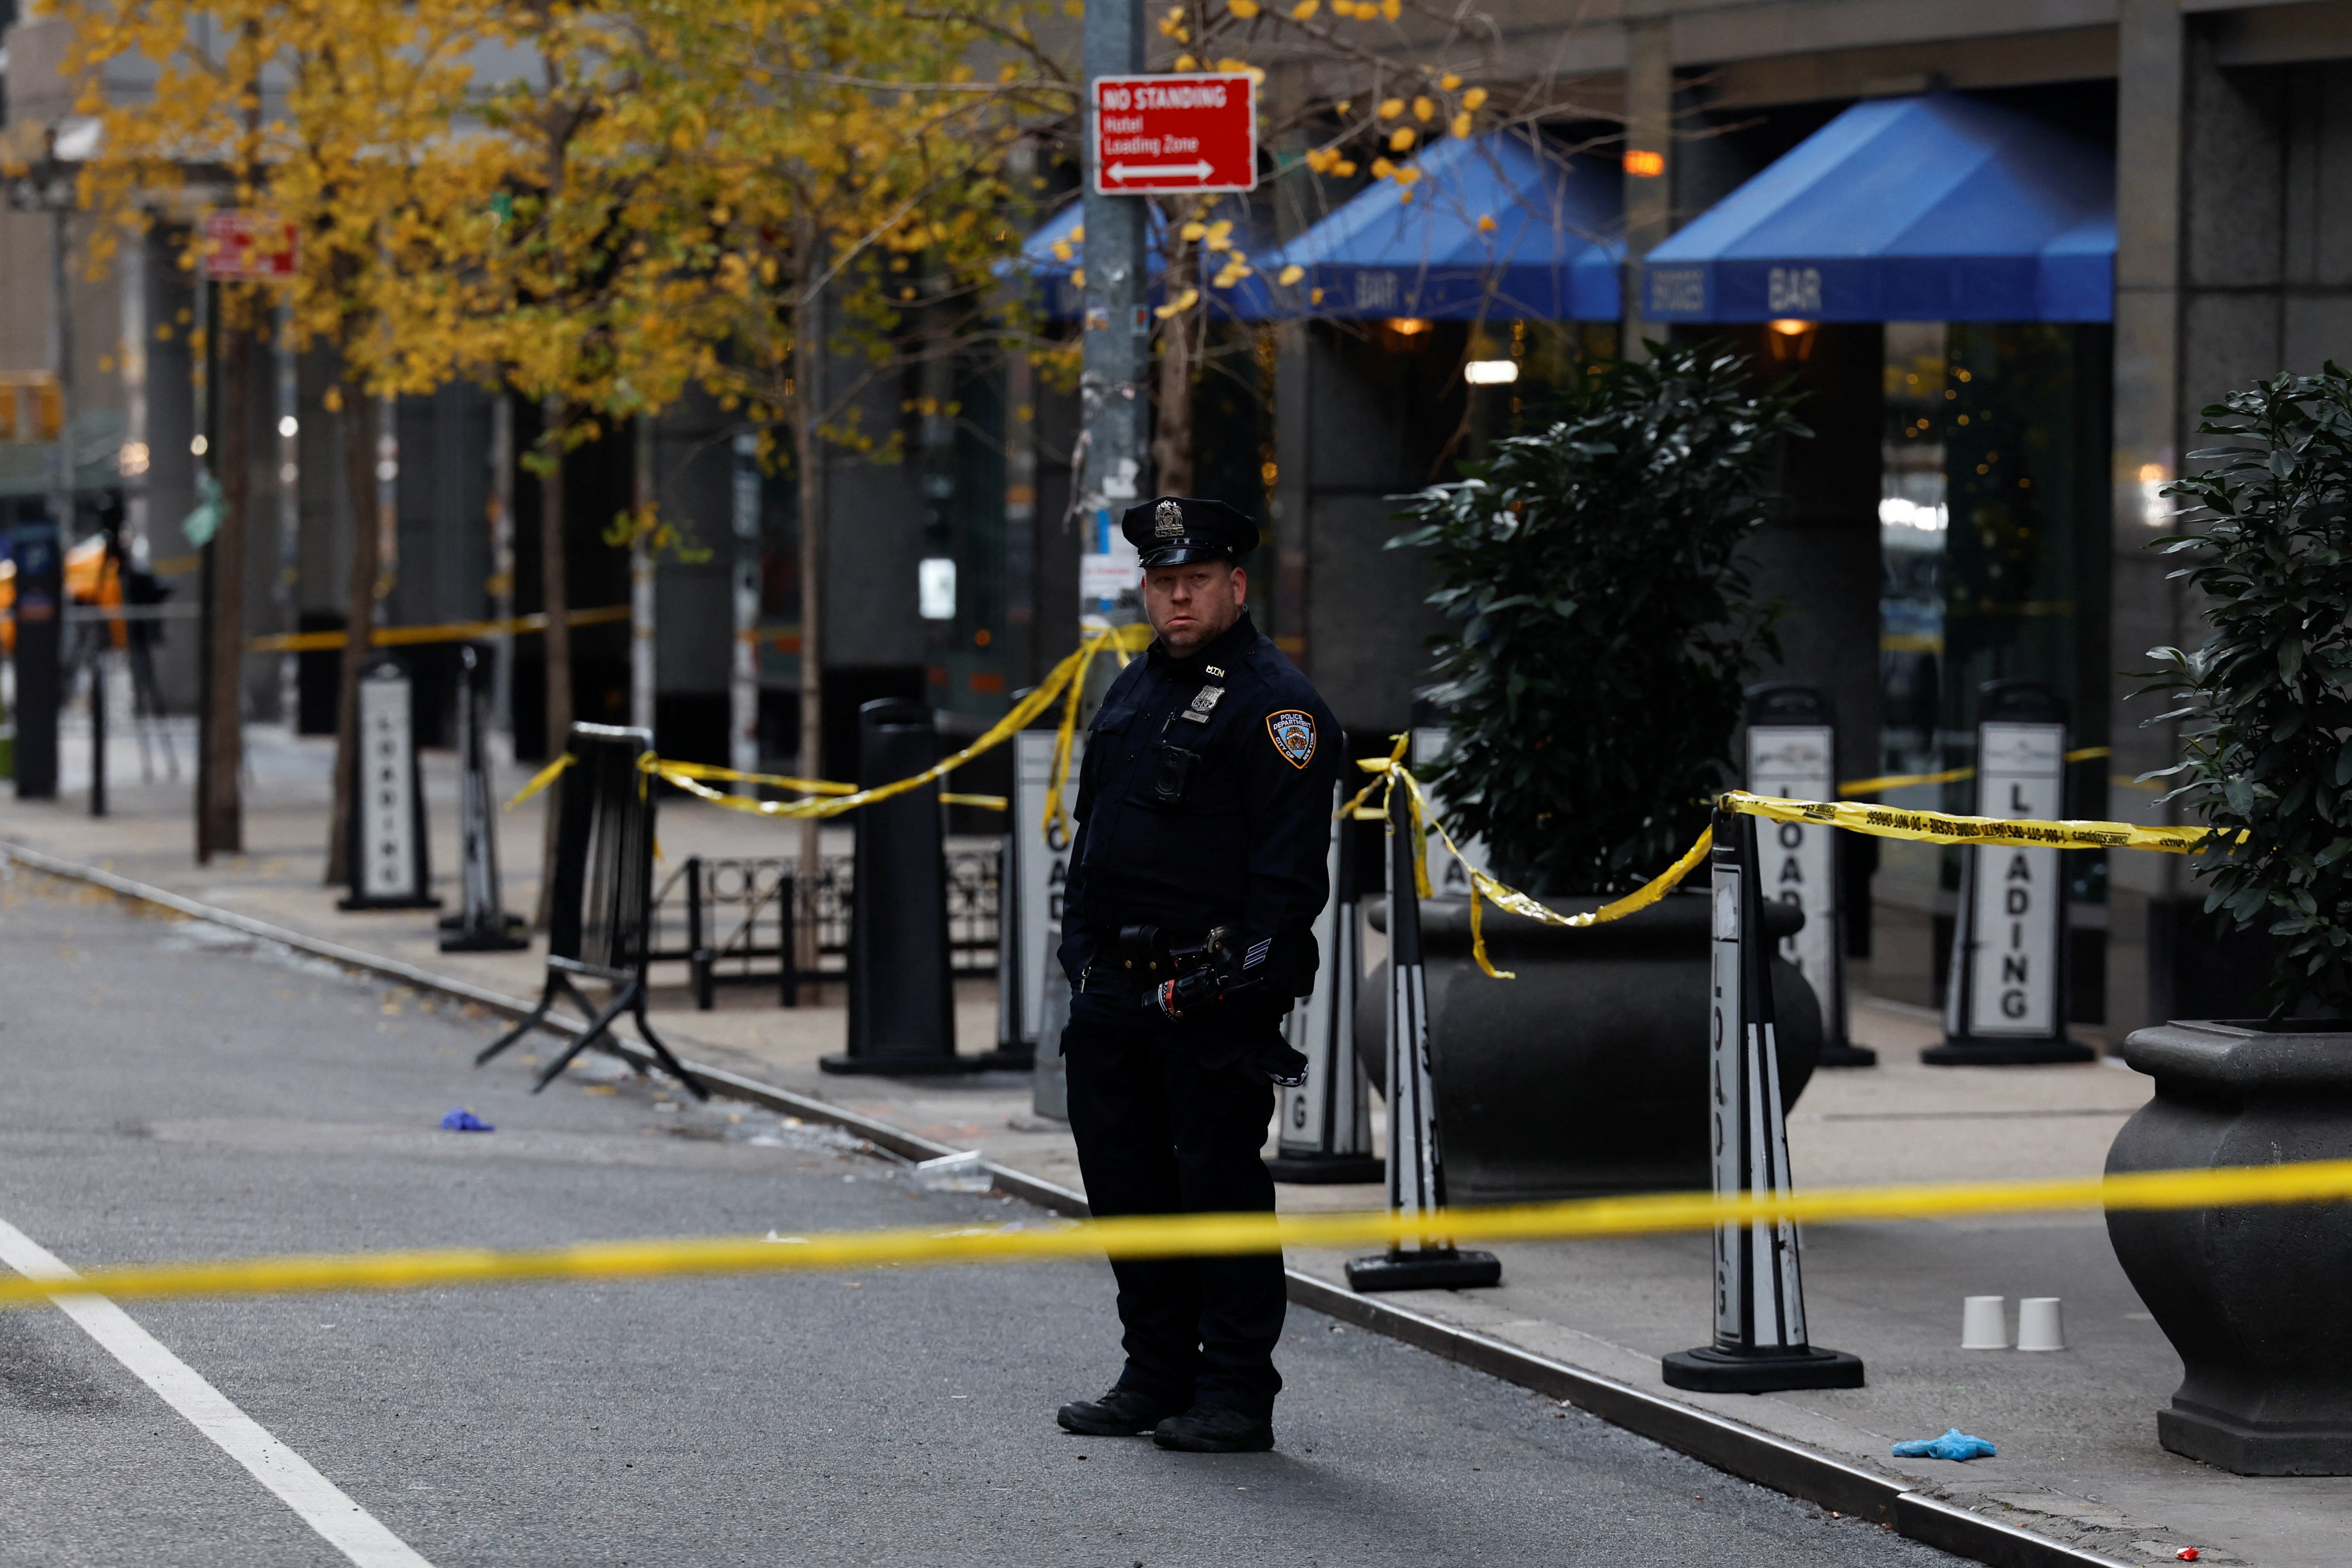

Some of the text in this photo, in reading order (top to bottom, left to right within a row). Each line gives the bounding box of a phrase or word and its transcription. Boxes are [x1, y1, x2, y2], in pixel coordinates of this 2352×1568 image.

[1102, 85, 1227, 111] NO STANDING
[1104, 115, 1143, 134] Hotel
[1104, 134, 1200, 157] Loading Zone
[1768, 267, 1822, 312] BAR
[1273, 719, 1311, 730] DEPARTMENT
[1276, 737, 1294, 759] CITY OF
[1303, 748, 1312, 761] NEW
[1894, 814, 1909, 830] NOT
[1909, 816, 1922, 831] DO
[1929, 818, 1954, 836] SCENE
[2001, 783, 2032, 1020] LADING
